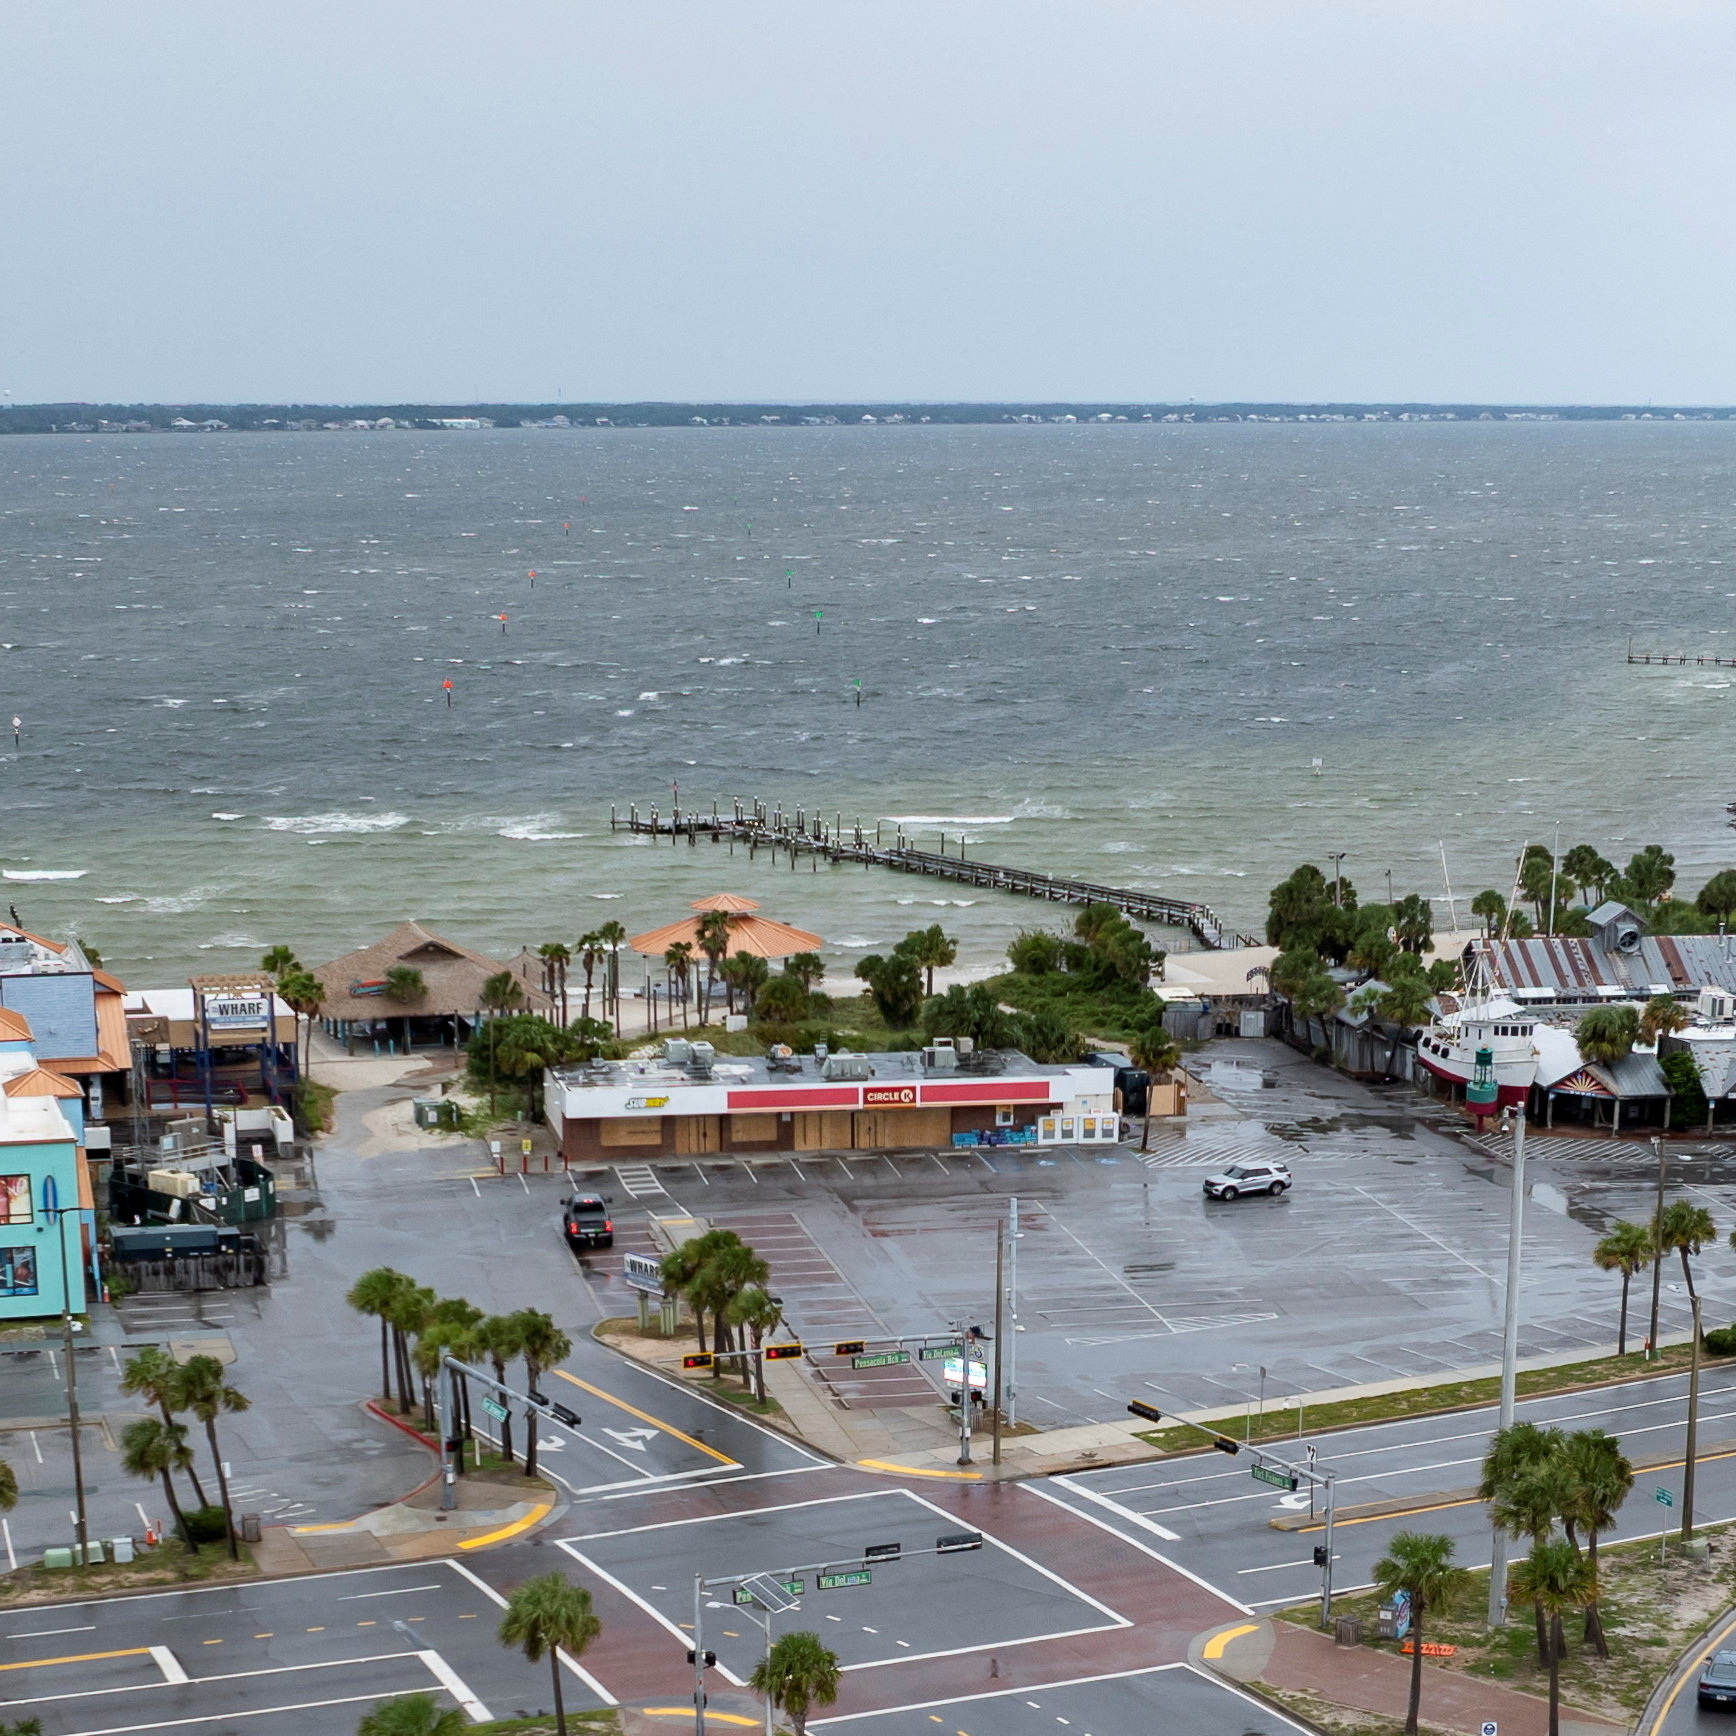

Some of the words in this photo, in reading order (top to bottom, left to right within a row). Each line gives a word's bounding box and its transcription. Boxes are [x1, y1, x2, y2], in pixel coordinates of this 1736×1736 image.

[218, 1002, 263, 1016] WHARF
[867, 1091, 900, 1101] CIRCLE
[855, 1356, 886, 1369] Pensacola
[887, 1355, 899, 1364] Bch
[821, 1576, 832, 1588] Via
